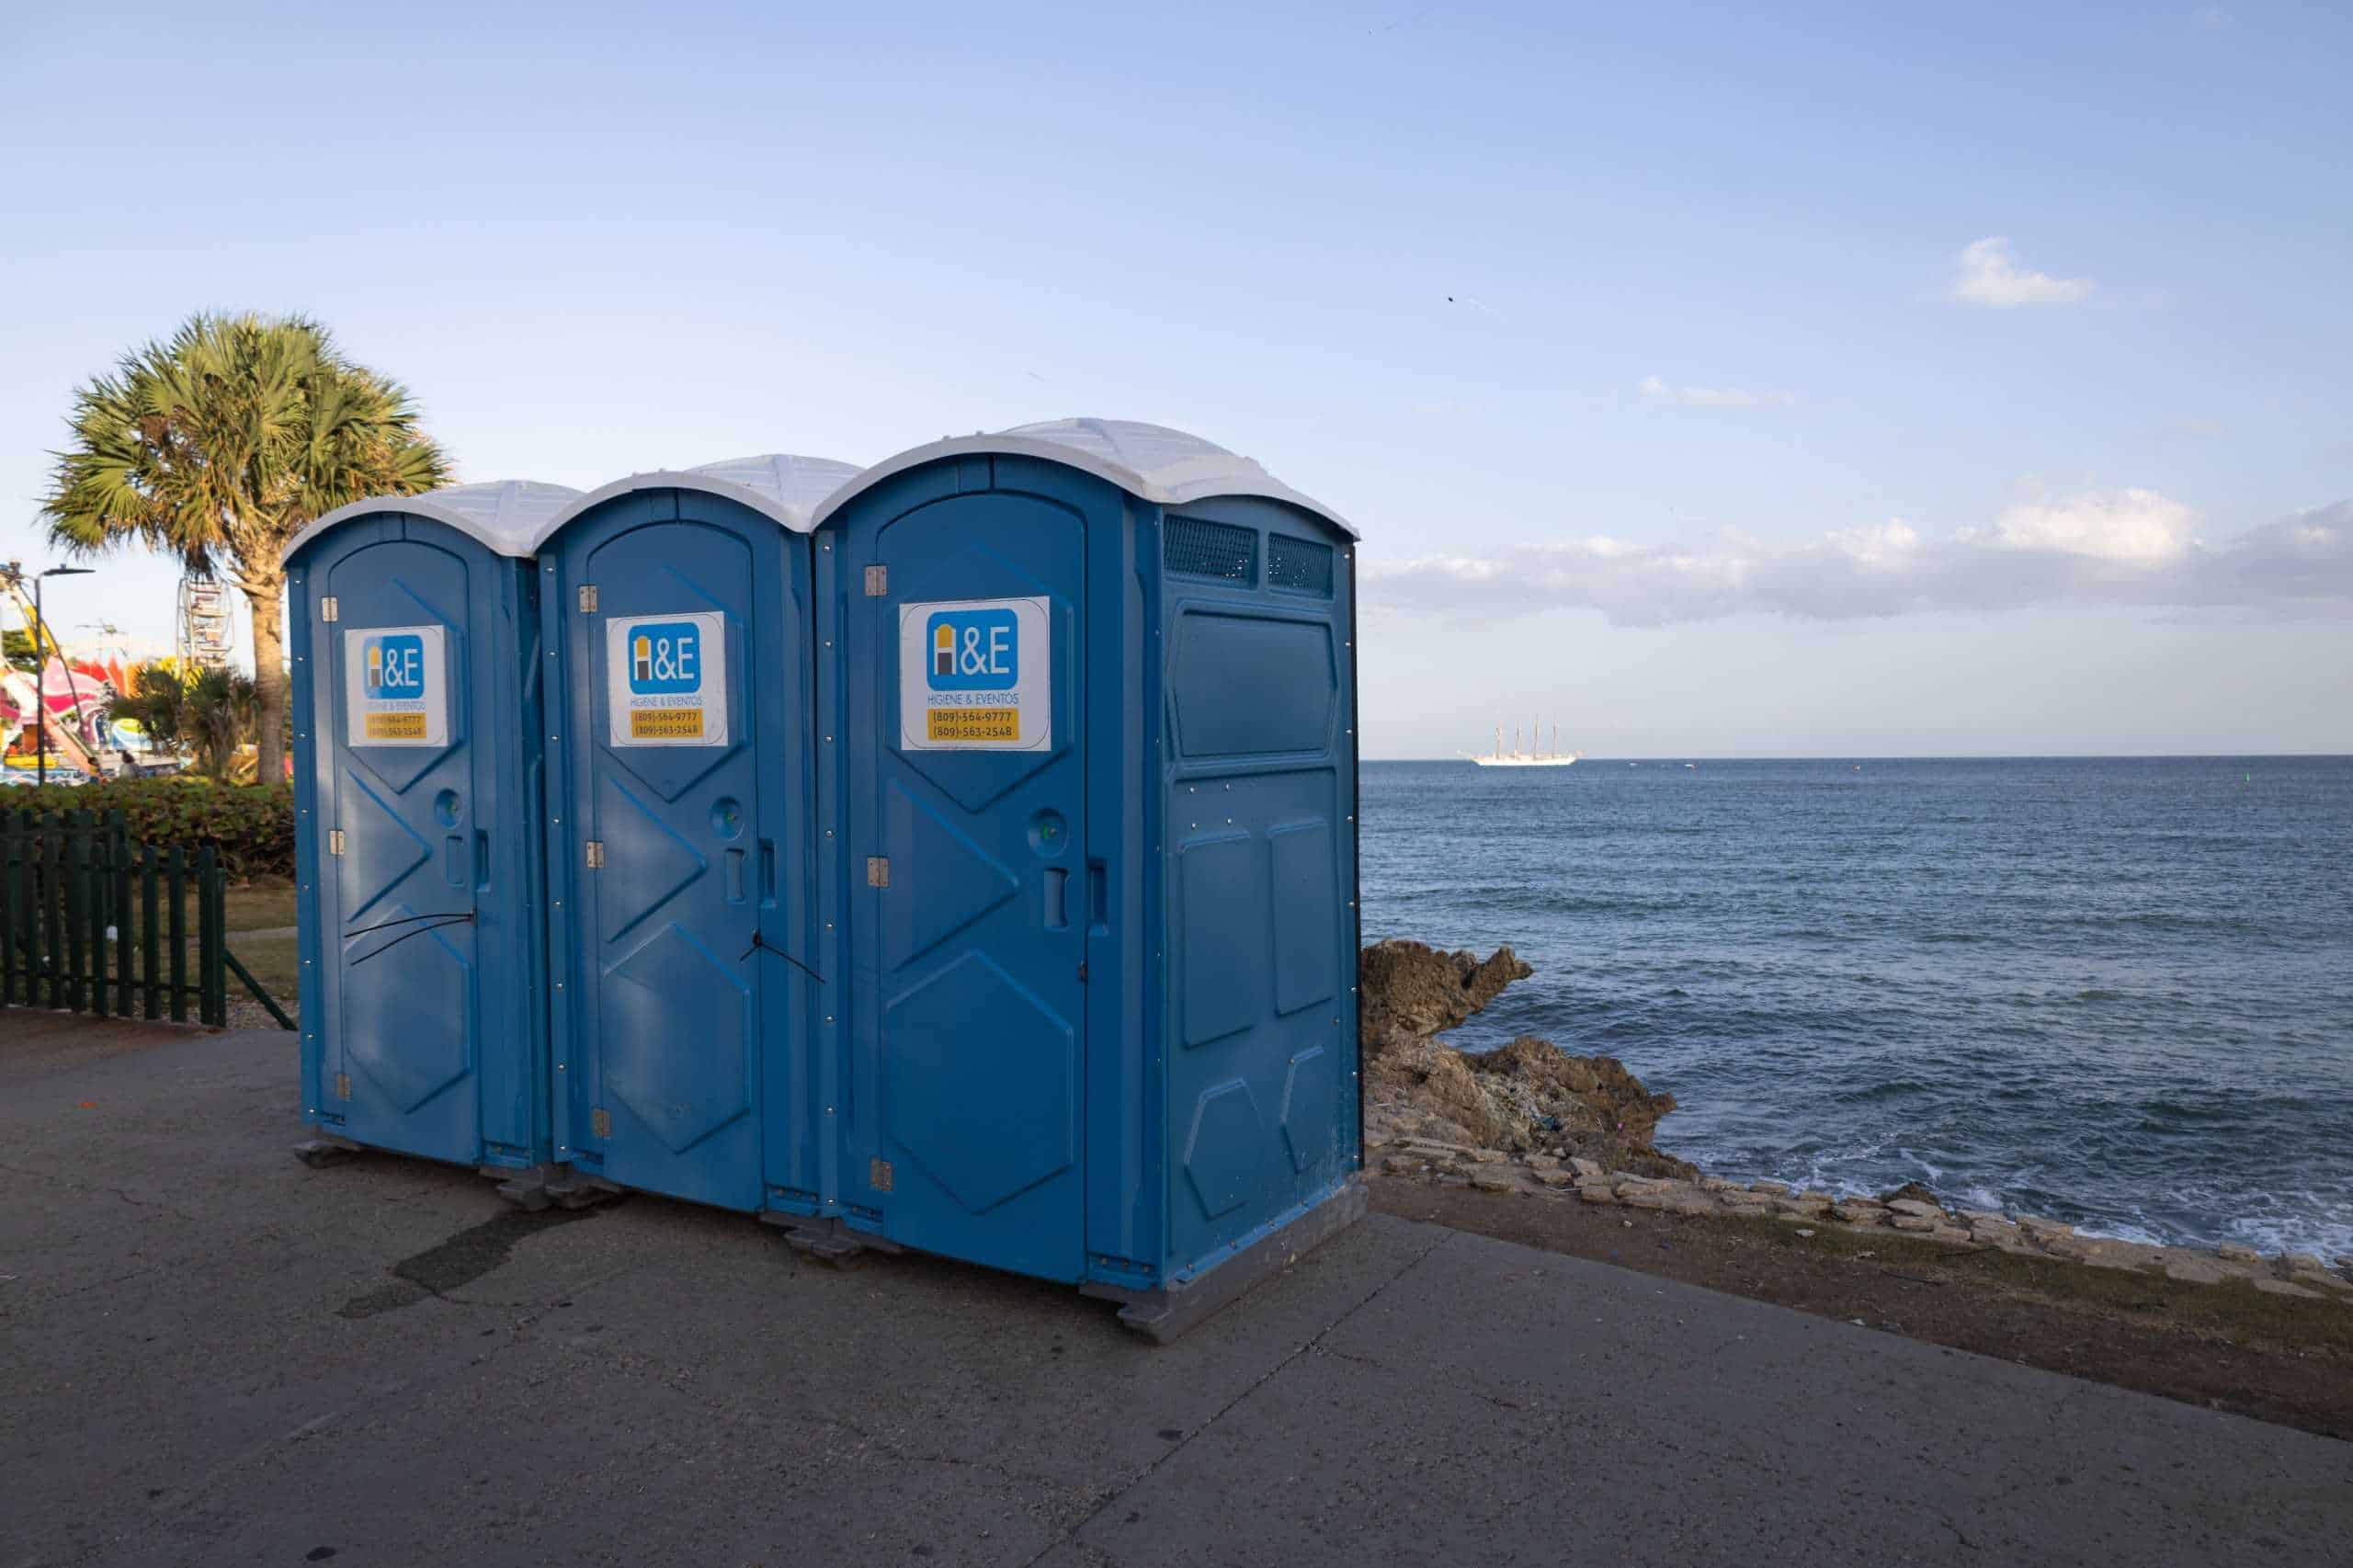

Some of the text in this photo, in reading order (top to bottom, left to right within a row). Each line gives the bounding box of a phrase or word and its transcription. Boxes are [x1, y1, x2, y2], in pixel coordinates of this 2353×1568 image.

[369, 647, 419, 687] H&E
[633, 635, 694, 680] H&E
[934, 624, 1010, 676] H&E
[927, 693, 1019, 706] HIGIENE & EVENTOS
